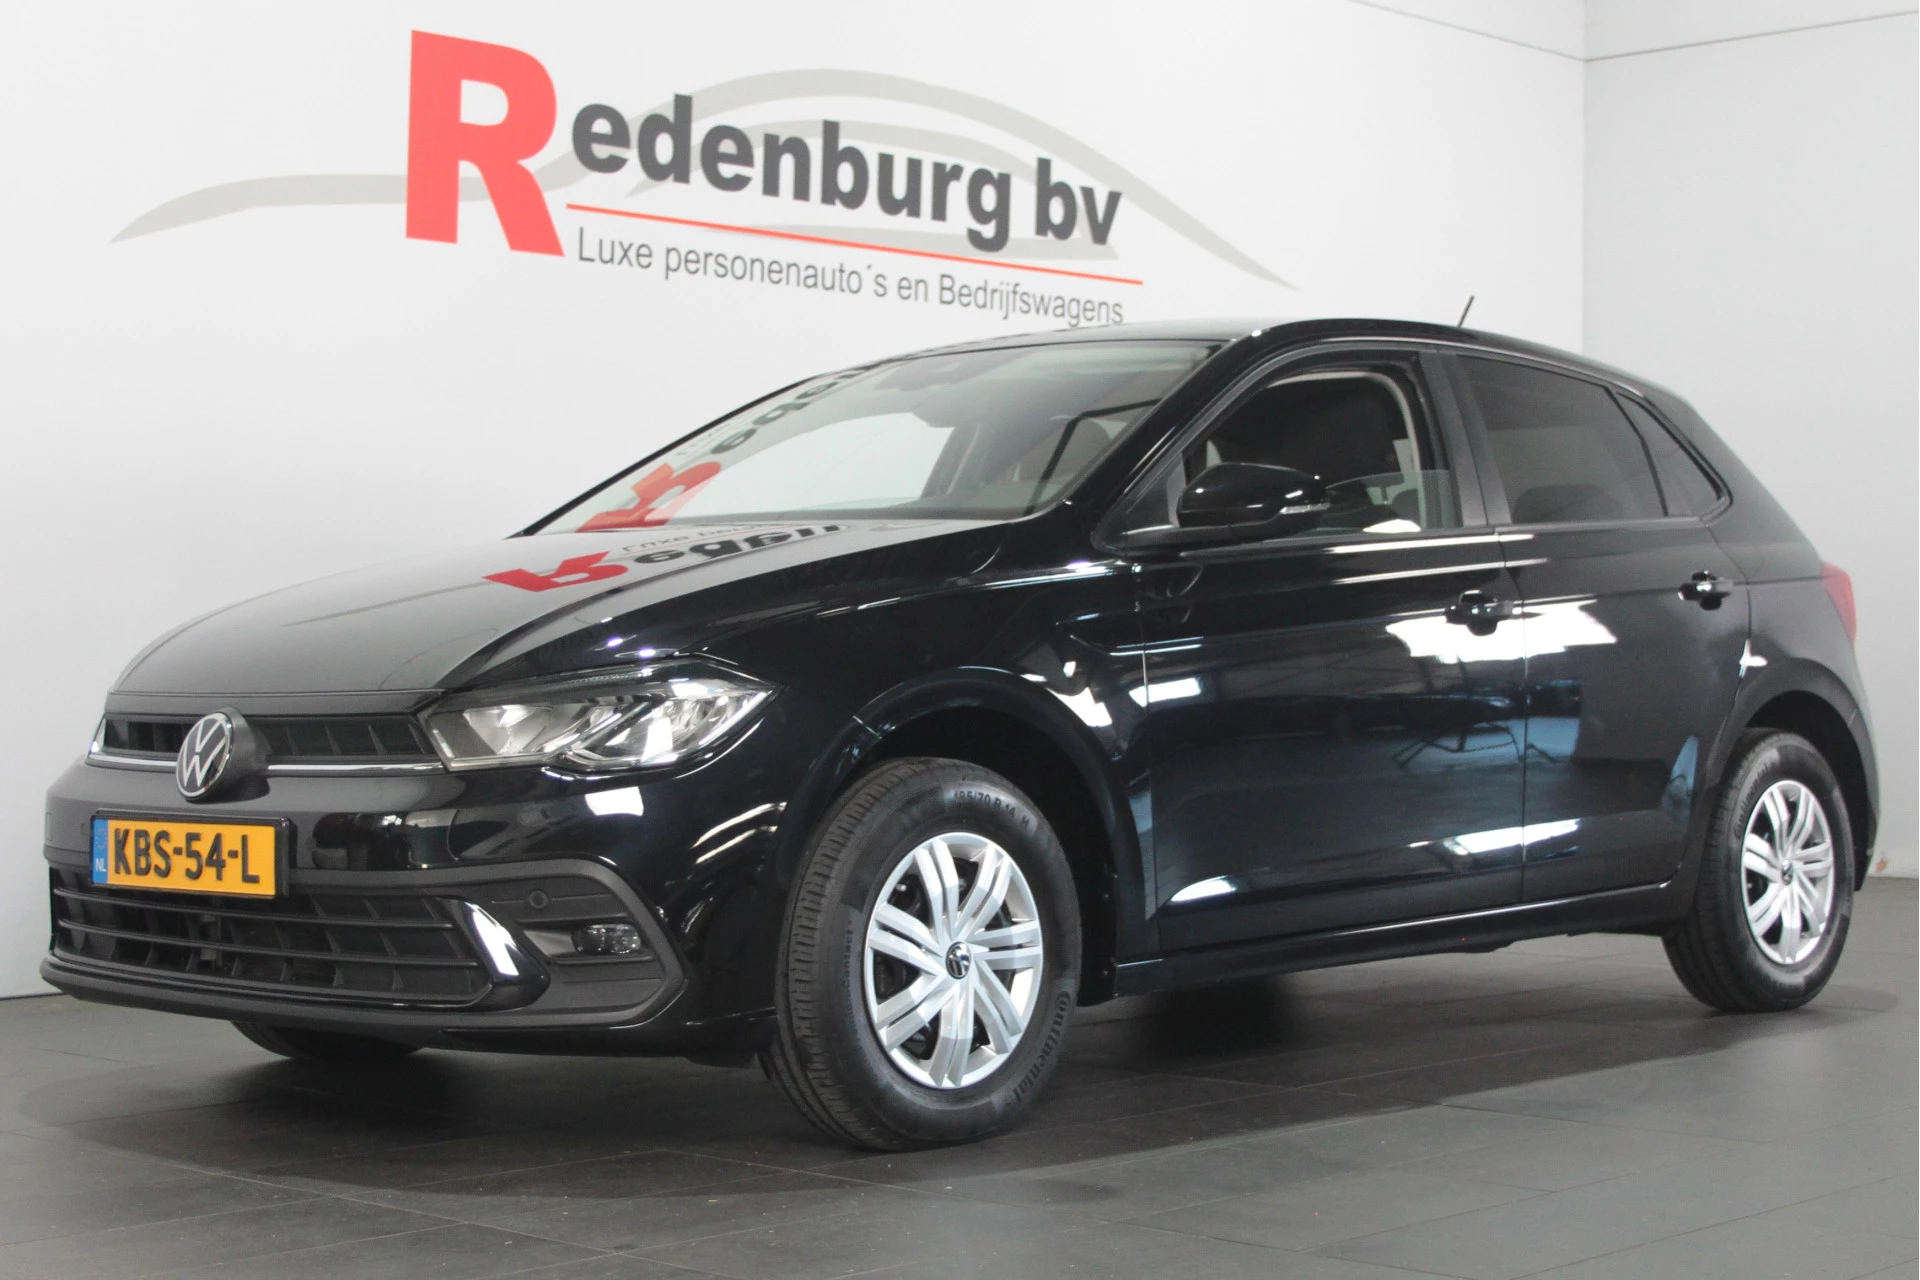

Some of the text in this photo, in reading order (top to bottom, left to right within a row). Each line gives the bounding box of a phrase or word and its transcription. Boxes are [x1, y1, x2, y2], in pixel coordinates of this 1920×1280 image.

[405, 29, 1123, 257] Redenburg bv
[578, 226, 653, 269] Luxe
[897, 276, 929, 302] en
[938, 273, 1124, 328] Bedrijfswagens
[95, 857, 107, 873] NL
[114, 828, 260, 884] KBS-54-L
[1013, 990, 1071, 1101] Continental
